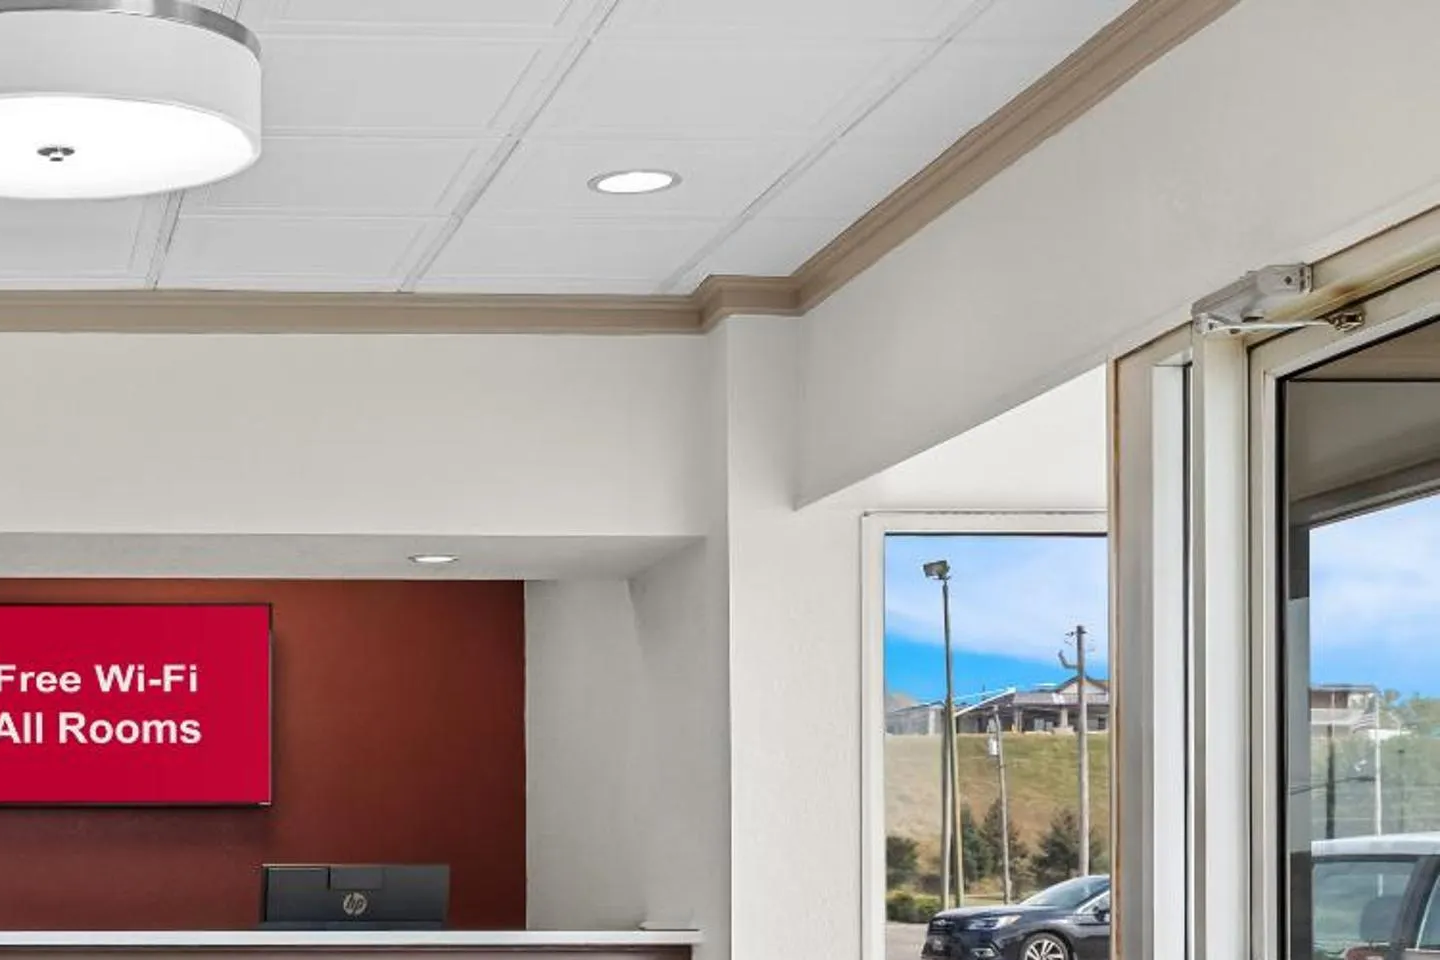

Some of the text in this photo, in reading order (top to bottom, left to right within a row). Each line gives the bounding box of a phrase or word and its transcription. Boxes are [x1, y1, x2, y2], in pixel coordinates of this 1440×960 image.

[93, 663, 199, 694] Wi-Fi
[58, 711, 202, 745] Rooms
[343, 892, 367, 916] hp
